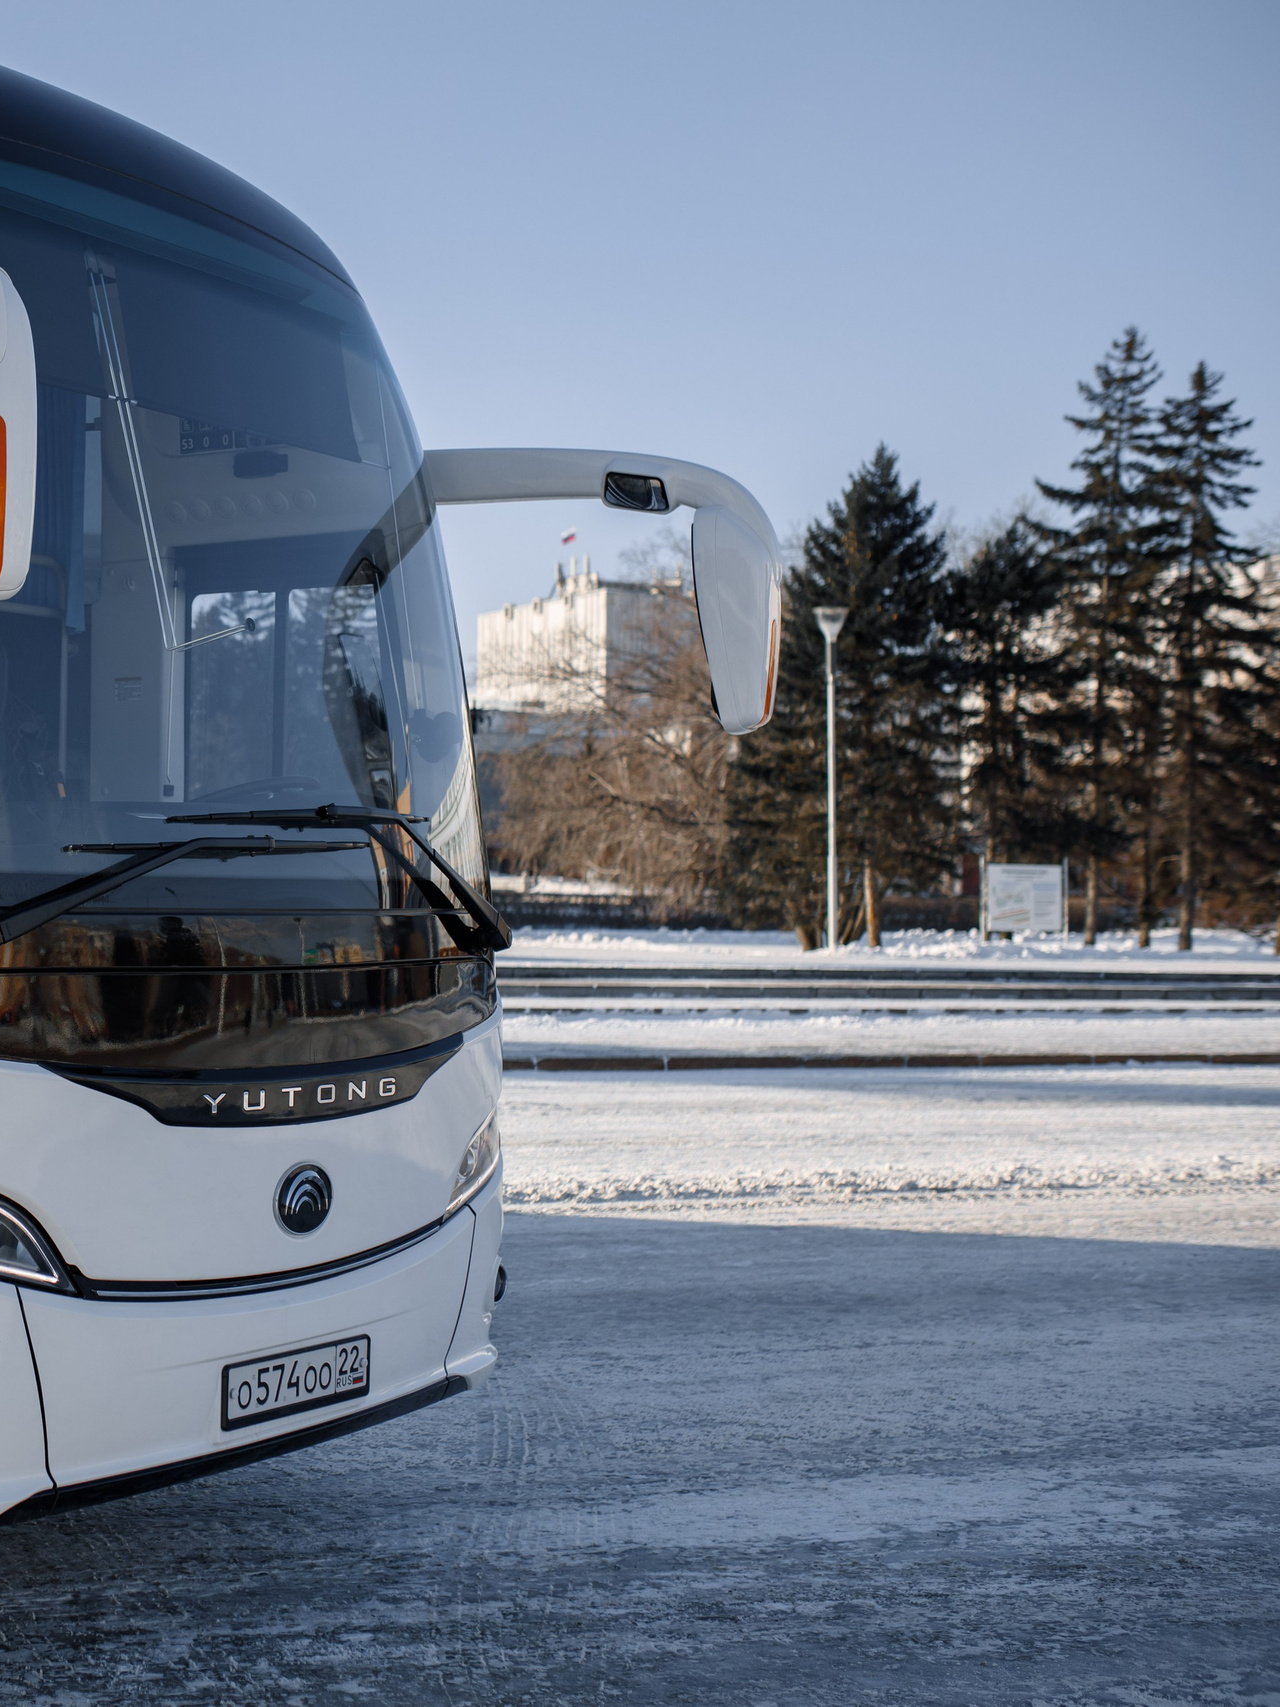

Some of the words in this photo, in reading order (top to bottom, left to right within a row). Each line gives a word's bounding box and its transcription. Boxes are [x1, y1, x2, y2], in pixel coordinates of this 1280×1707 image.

[182, 438, 194, 450] 53
[203, 436, 210, 448] 0
[222, 434, 229, 446] 0
[203, 1077, 397, 1115] YUTONG
[338, 1345, 360, 1376] 22
[336, 1374, 353, 1388] RUS
